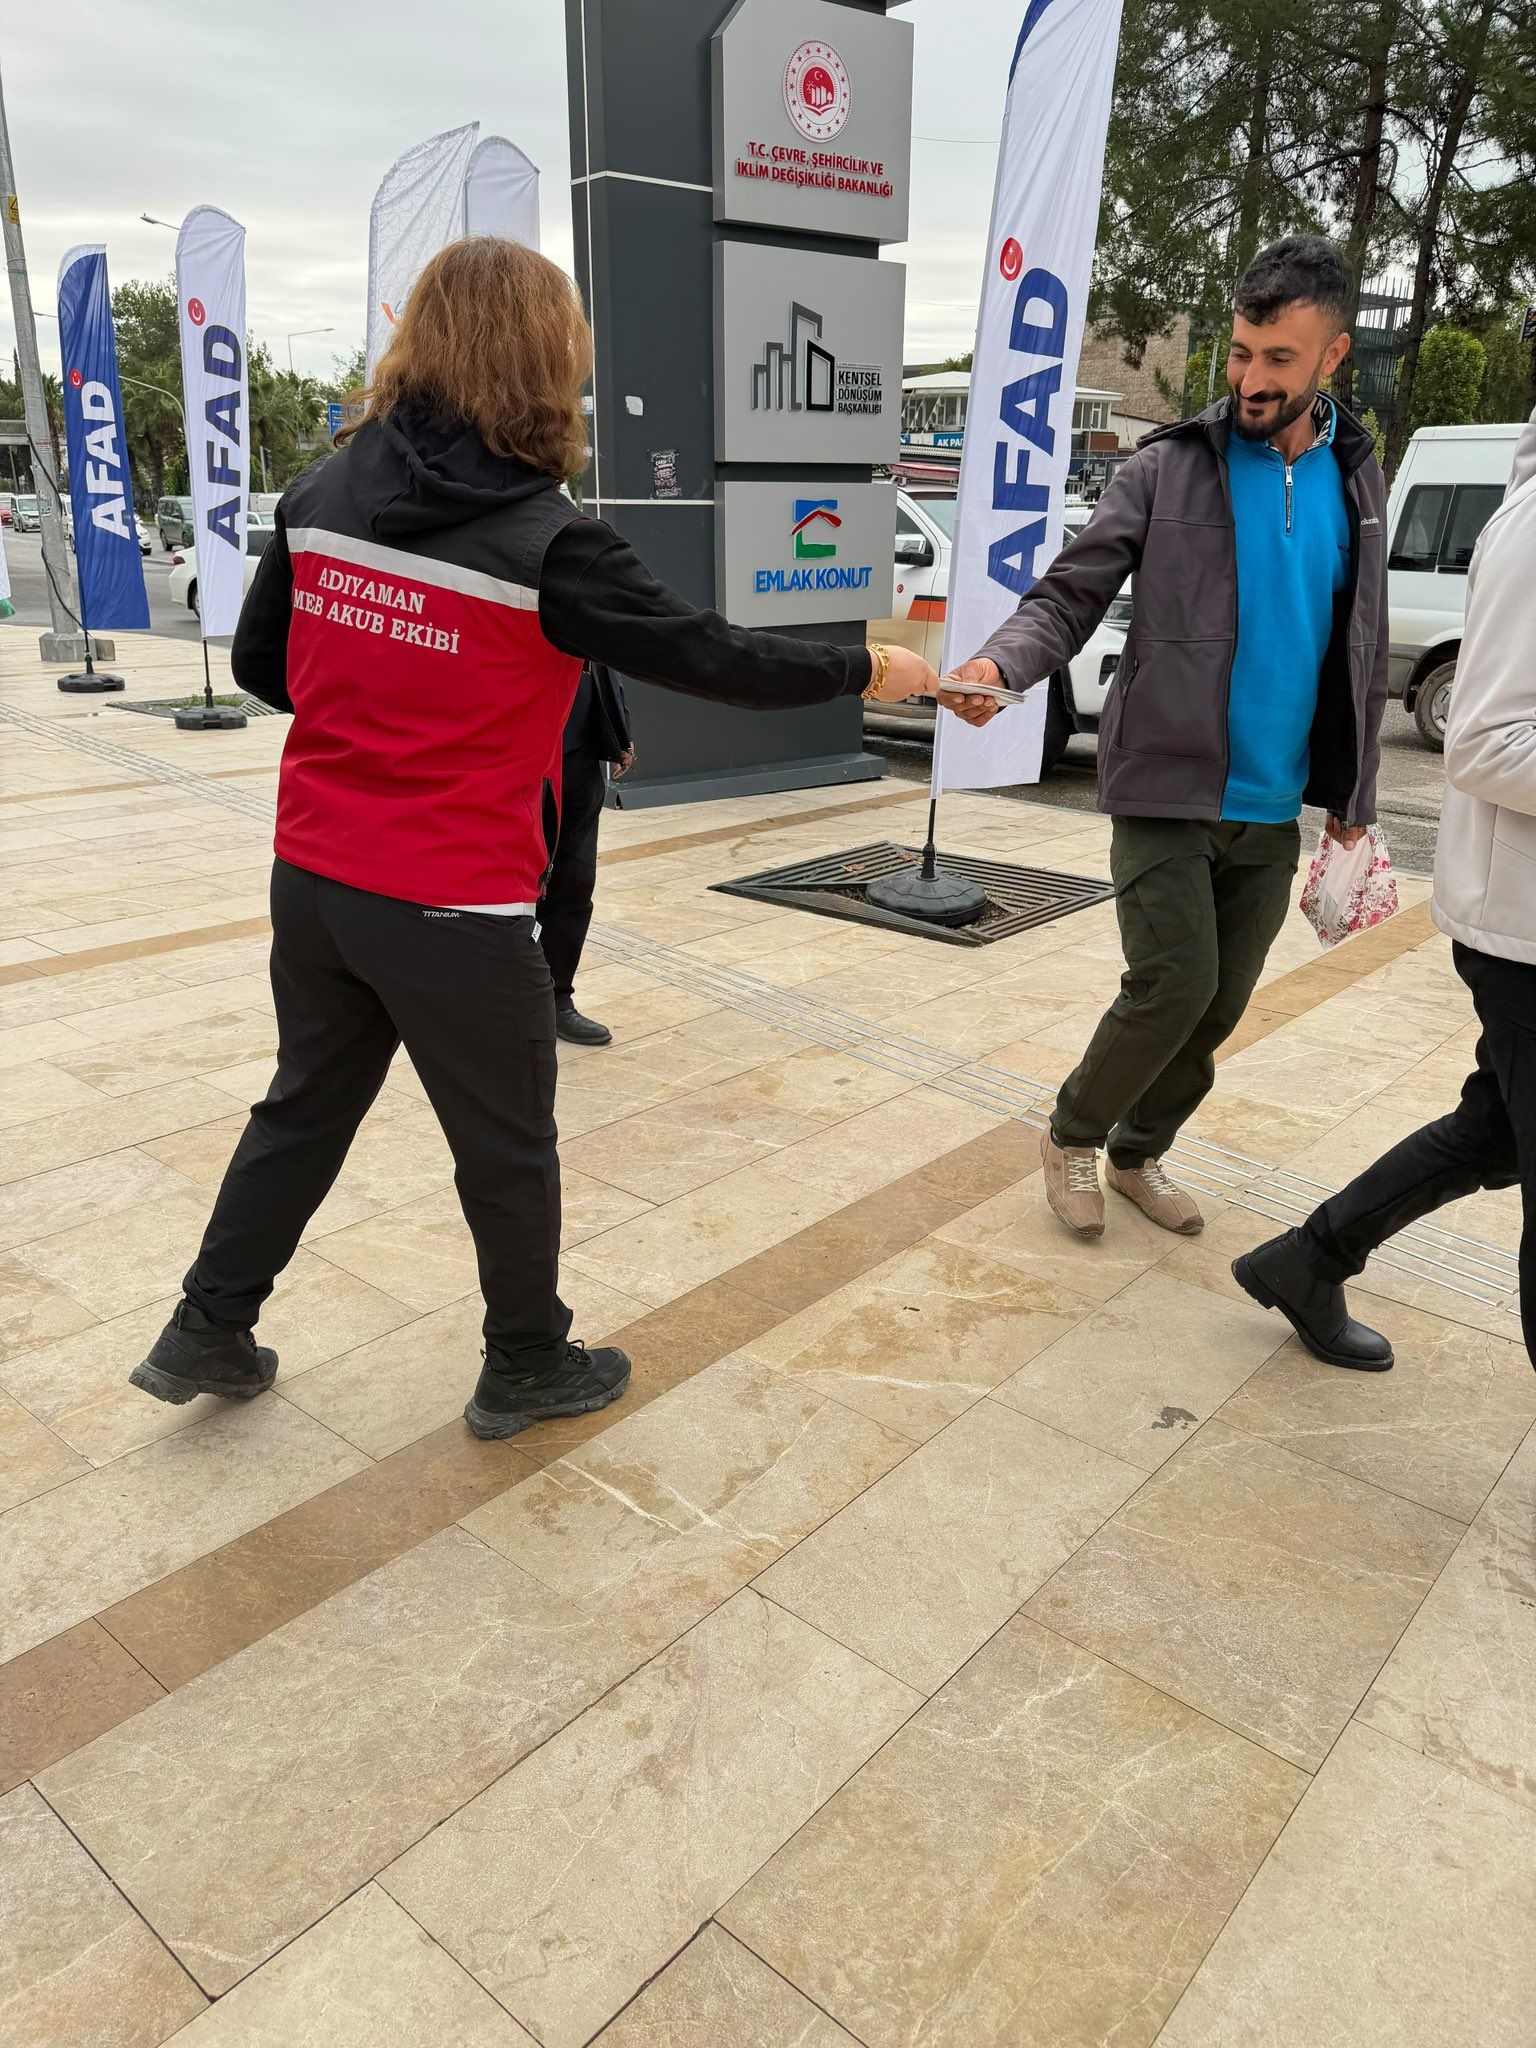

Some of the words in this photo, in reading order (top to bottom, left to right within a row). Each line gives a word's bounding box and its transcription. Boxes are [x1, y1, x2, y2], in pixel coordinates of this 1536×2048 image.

[748, 142, 769, 157] T.C.
[772, 146, 809, 165] ÇEVRE,
[870, 162, 884, 176] VE
[736, 158, 769, 179] İKLİM
[771, 164, 836, 188] DEĞİŞİKLİĞİ
[838, 177, 893, 197] BAKANLIĞI
[838, 370, 882, 386] KENTSEL
[838, 386, 882, 403] DÖNÜŞÜM
[838, 402, 882, 415] BAŞKANLIĞI
[203, 324, 242, 551] AFAD
[937, 439, 949, 447] AK
[950, 439, 964, 448] PA
[987, 267, 1068, 597] AFAD
[81, 380, 131, 540] AFAD
[317, 567, 426, 615] ADIYAMAN
[754, 568, 812, 593] EMLAK
[815, 566, 873, 590] KONUT
[293, 588, 324, 616] MEB
[326, 601, 385, 635] AKUB
[389, 618, 461, 654] EKİBİ
[422, 910, 460, 918] TITANIUM
